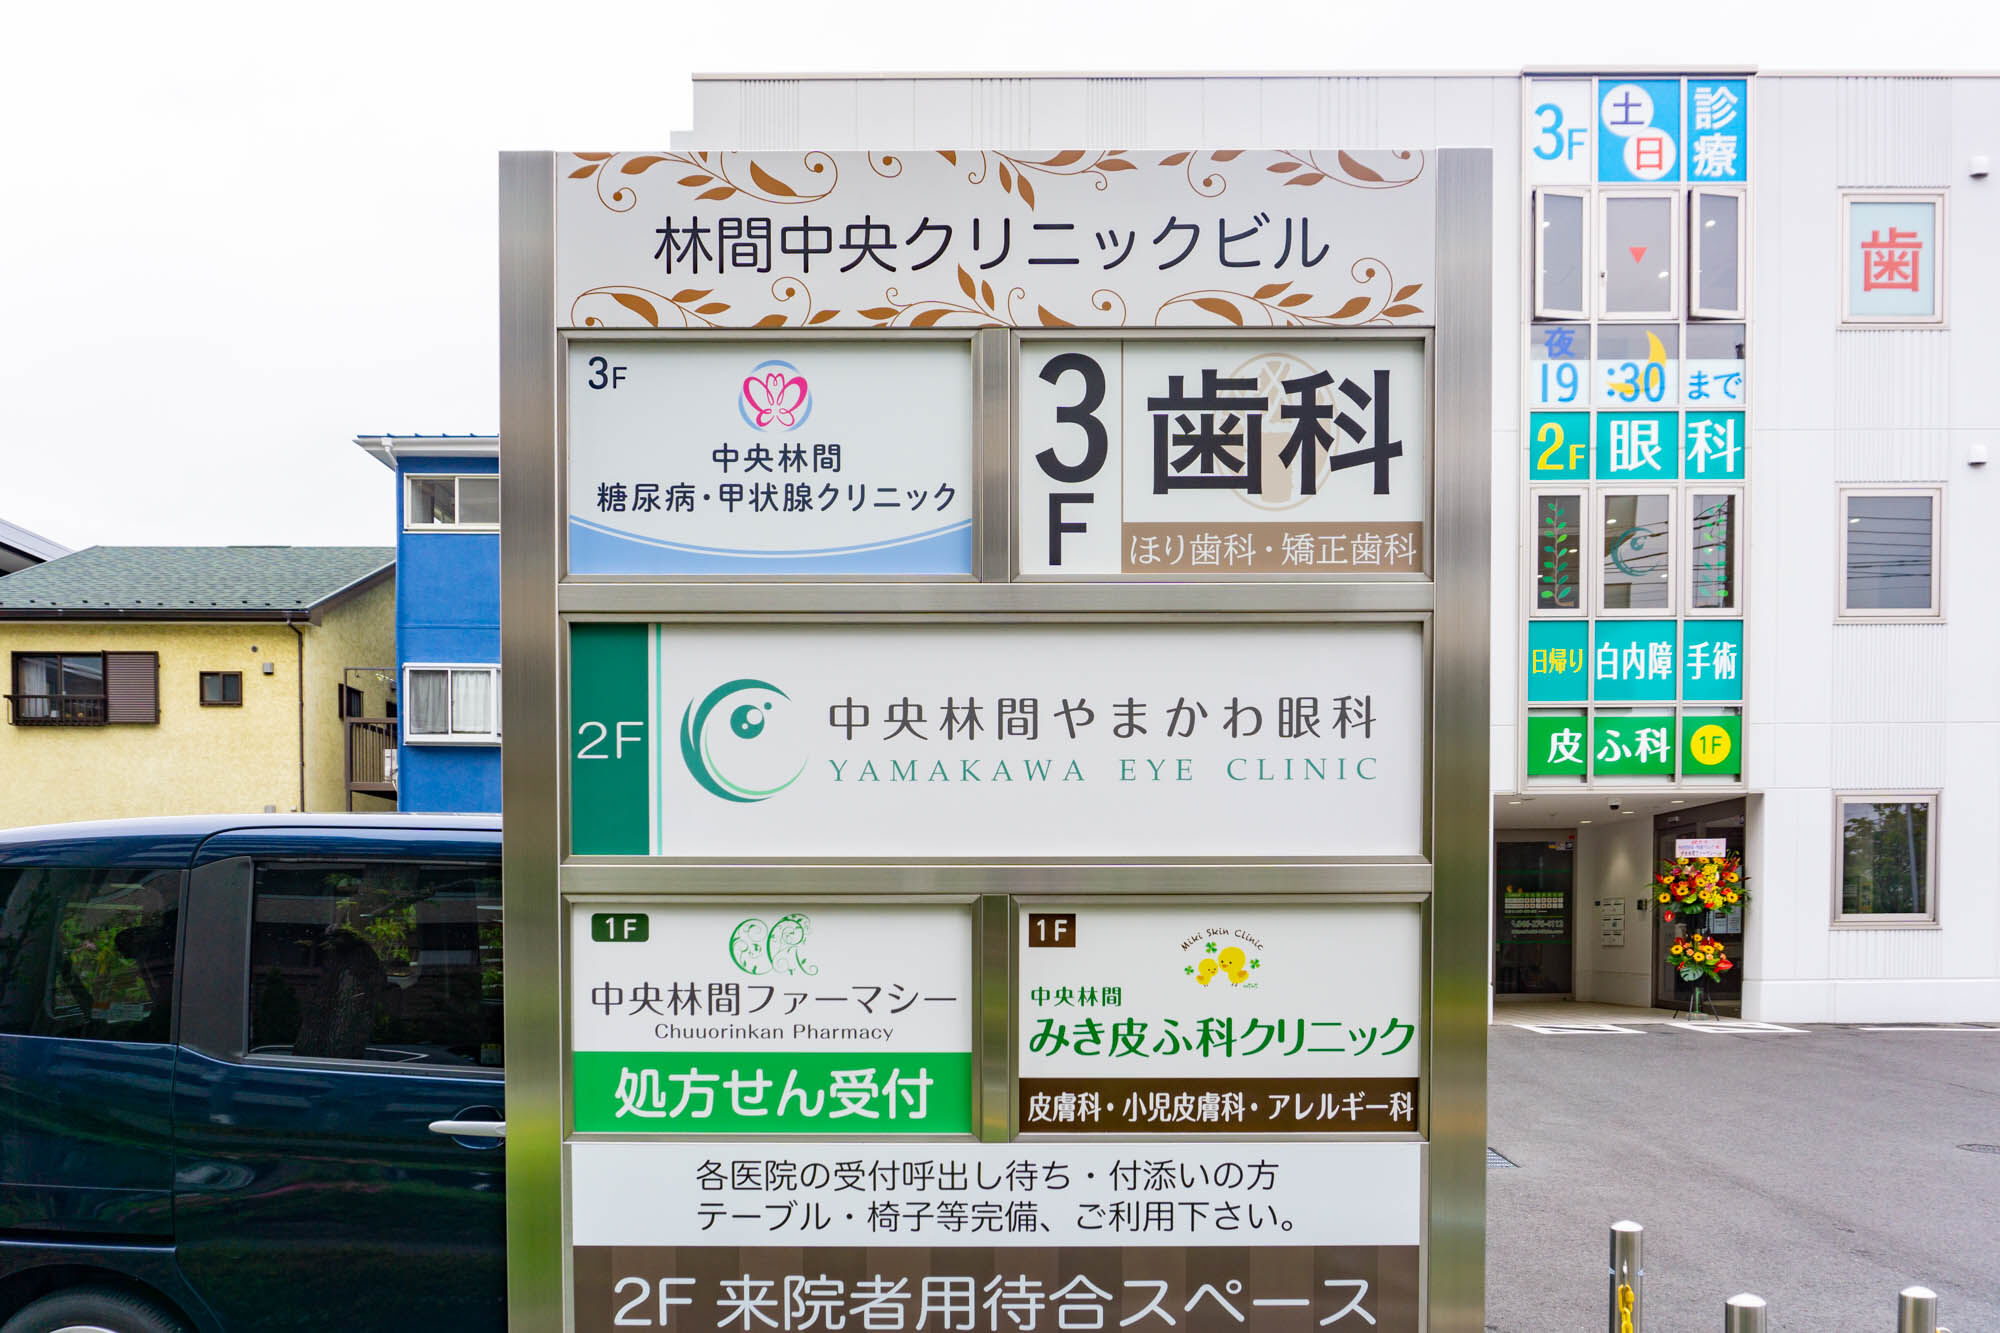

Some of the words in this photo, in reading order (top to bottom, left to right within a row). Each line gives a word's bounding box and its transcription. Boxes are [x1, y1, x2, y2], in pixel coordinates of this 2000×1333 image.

[1533, 103, 1588, 160] 3F
[1693, 86, 1738, 177] 診療
[654, 214, 1330, 275] 林間中央クリニックビル
[1861, 226, 1923, 292] 歯
[587, 357, 628, 390] 3F
[1147, 368, 1403, 496] 歯科
[1536, 422, 1586, 471] 2F
[712, 443, 841, 474] 中央林間
[596, 481, 956, 513] 糖尿病・甲状腺クリニック
[1130, 530, 1417, 568] ほり歯科・矯正歯科
[829, 695, 1377, 741] 中央林間やまかわ眼科
[577, 721, 644, 760] 2F
[1699, 735, 1723, 755] 1F
[828, 759, 1086, 782] YAMAKAWA
[1119, 758, 1193, 782] EYE
[1226, 757, 1378, 782] CLINIC
[605, 917, 637, 940] 1F
[1036, 919, 1068, 942] 1F
[1181, 932, 1203, 952] Miki
[1206, 927, 1230, 937] Skin
[1233, 929, 1264, 951] Clinic
[591, 981, 957, 1017] 中央林間ファーマシー
[1030, 985, 1122, 1007] 中央林間
[654, 1023, 784, 1040] Chuuorinkan
[793, 1023, 894, 1042] Pharmacy
[1029, 1016, 1415, 1058] みき皮ふ科クリニック
[614, 1066, 934, 1120] 処方せん受付
[1027, 1090, 1414, 1123] 皮膚科・小児皮膚科・アレルギー科
[696, 1158, 1280, 1192] 各医院の受付呼出し待ち・付添いの方
[697, 1199, 1293, 1233] テーブル・椅子等完備、ご利用下さい。
[613, 1276, 697, 1327] 2F
[716, 1273, 1377, 1332] 来院者用待合スペース
